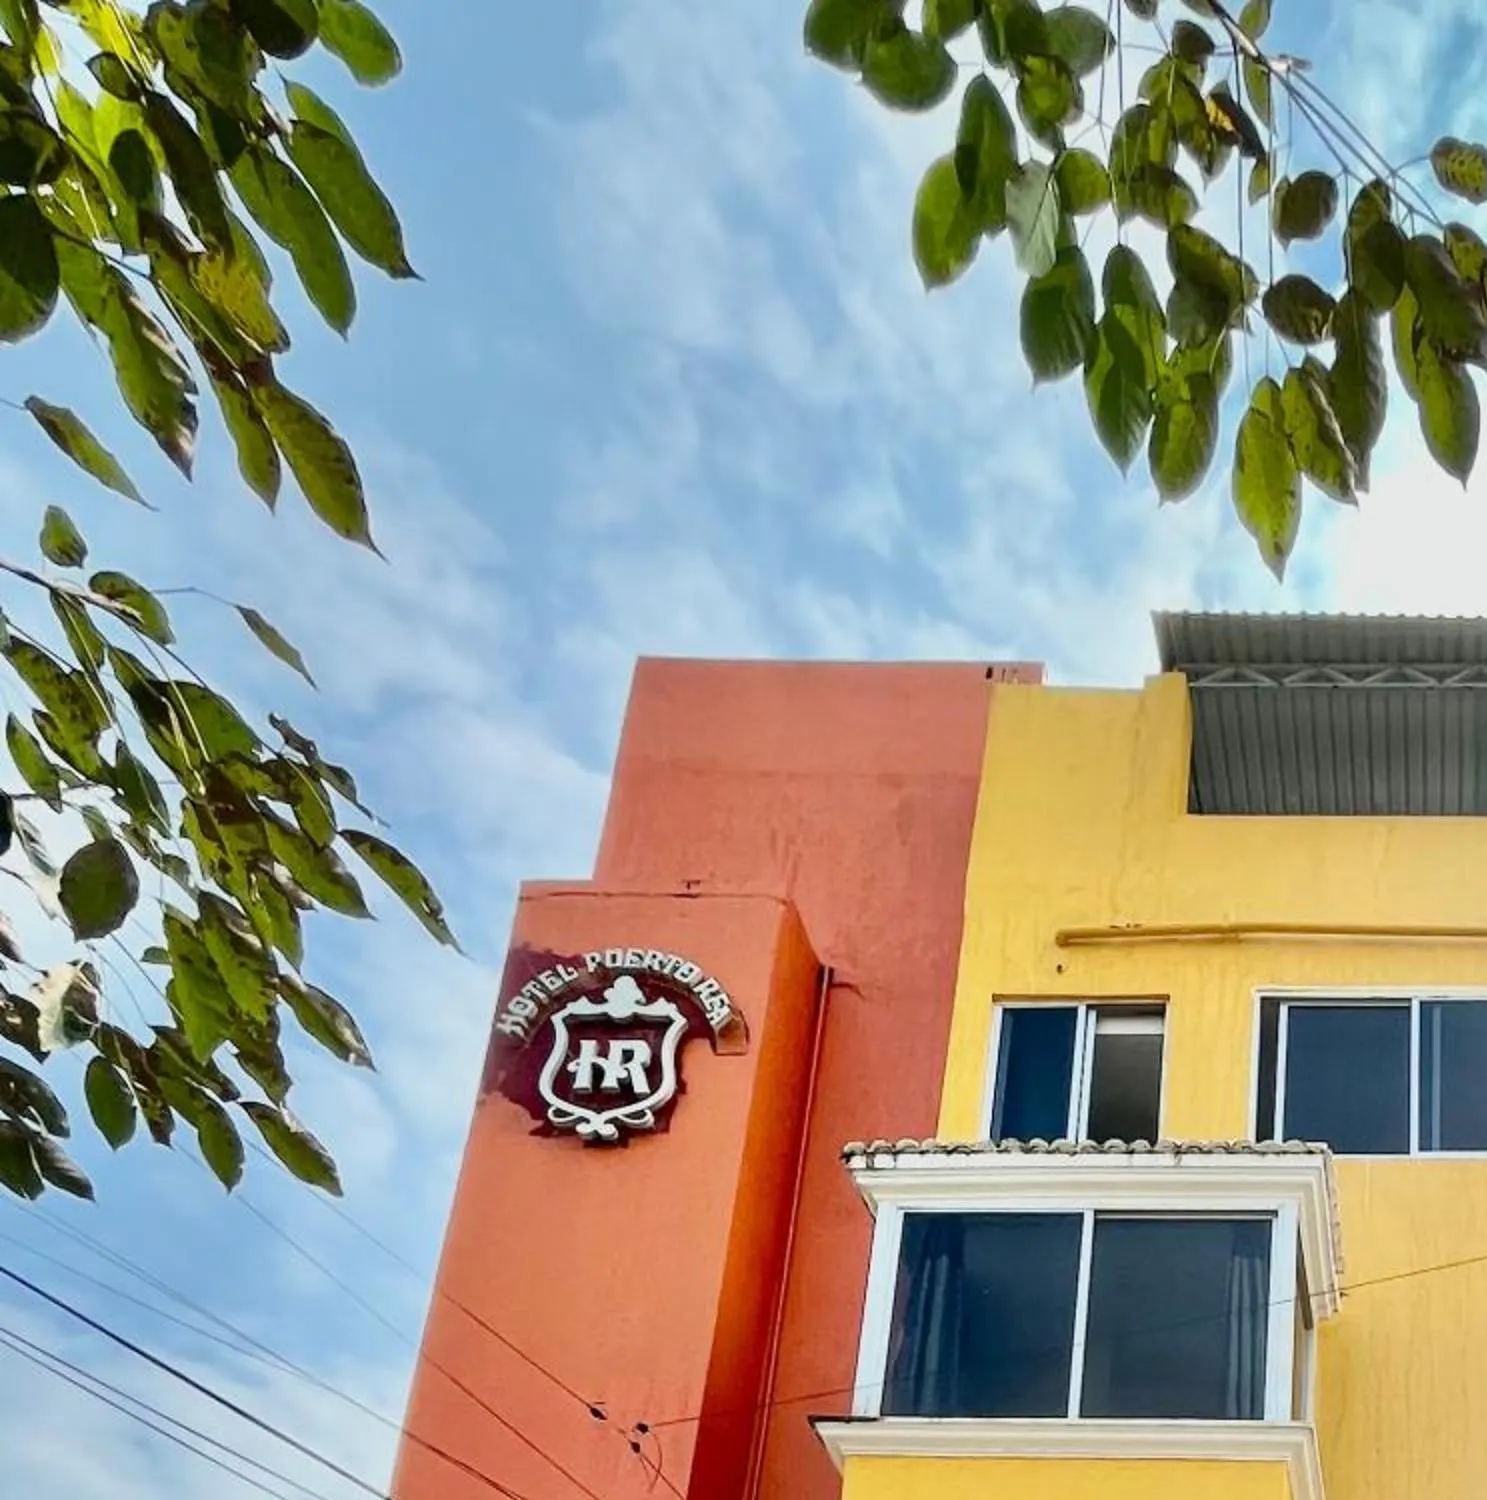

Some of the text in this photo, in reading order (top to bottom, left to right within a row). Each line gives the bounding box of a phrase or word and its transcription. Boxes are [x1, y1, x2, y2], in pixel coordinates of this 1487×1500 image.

[496, 964, 579, 1038] HOTEL
[583, 948, 702, 986] PUERTO
[567, 1040, 652, 1094] HR
